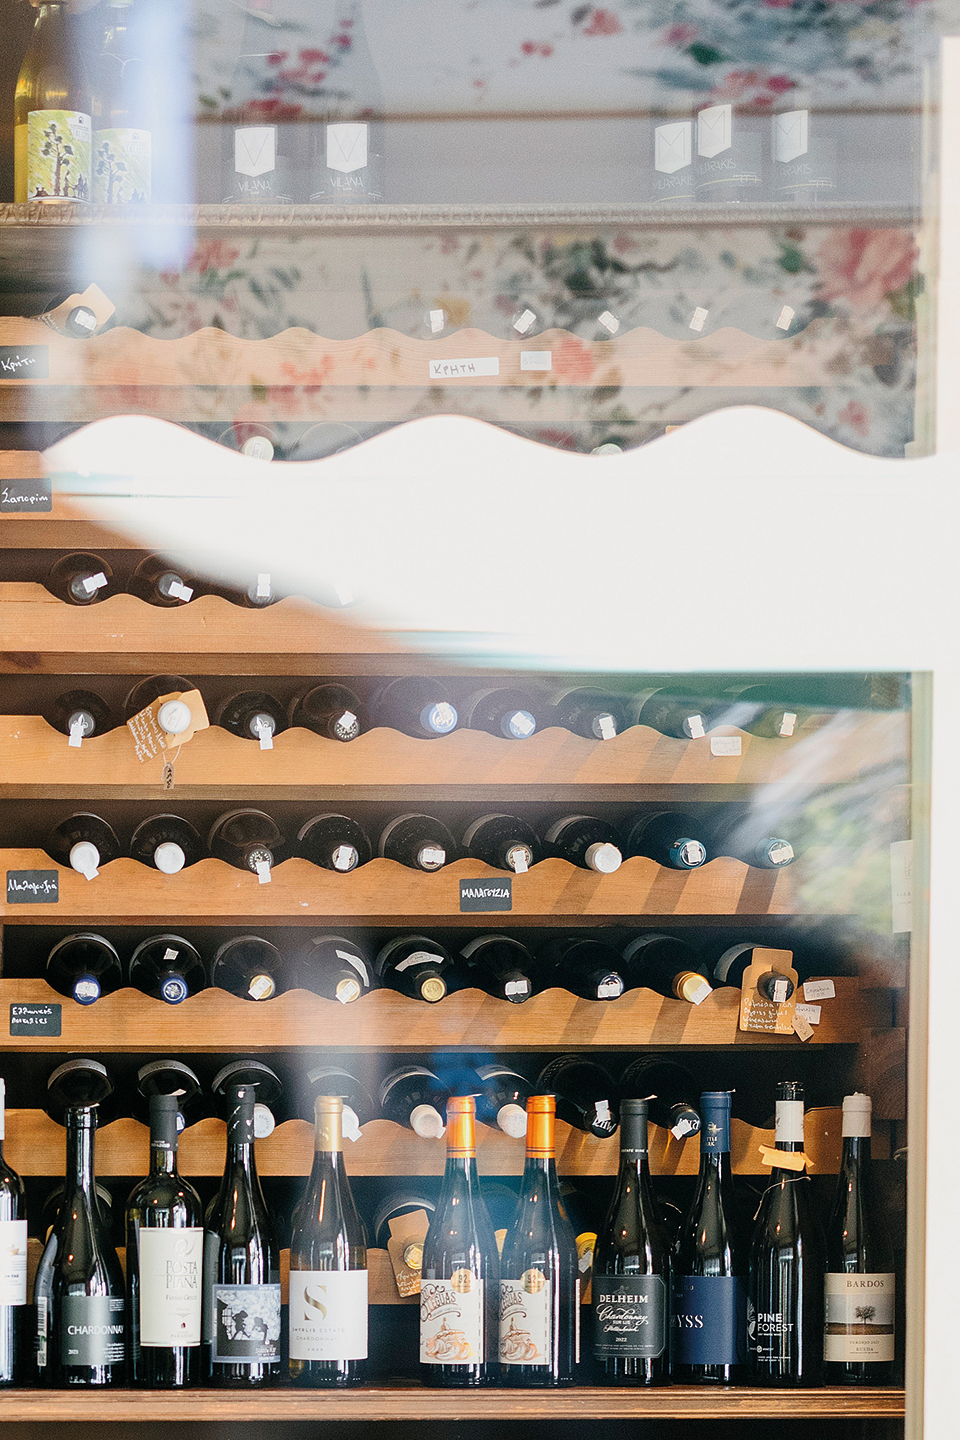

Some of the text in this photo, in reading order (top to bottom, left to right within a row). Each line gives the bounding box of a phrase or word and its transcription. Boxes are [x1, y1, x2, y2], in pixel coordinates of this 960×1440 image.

[166, 1260, 198, 1274] POSTA
[847, 1280, 884, 1288] BARDOS
[599, 1295, 648, 1303] DELHEIM
[757, 1313, 783, 1322] PINE
[67, 1325, 124, 1335] CHARDONNAY
[757, 1323, 794, 1331] FOREST
